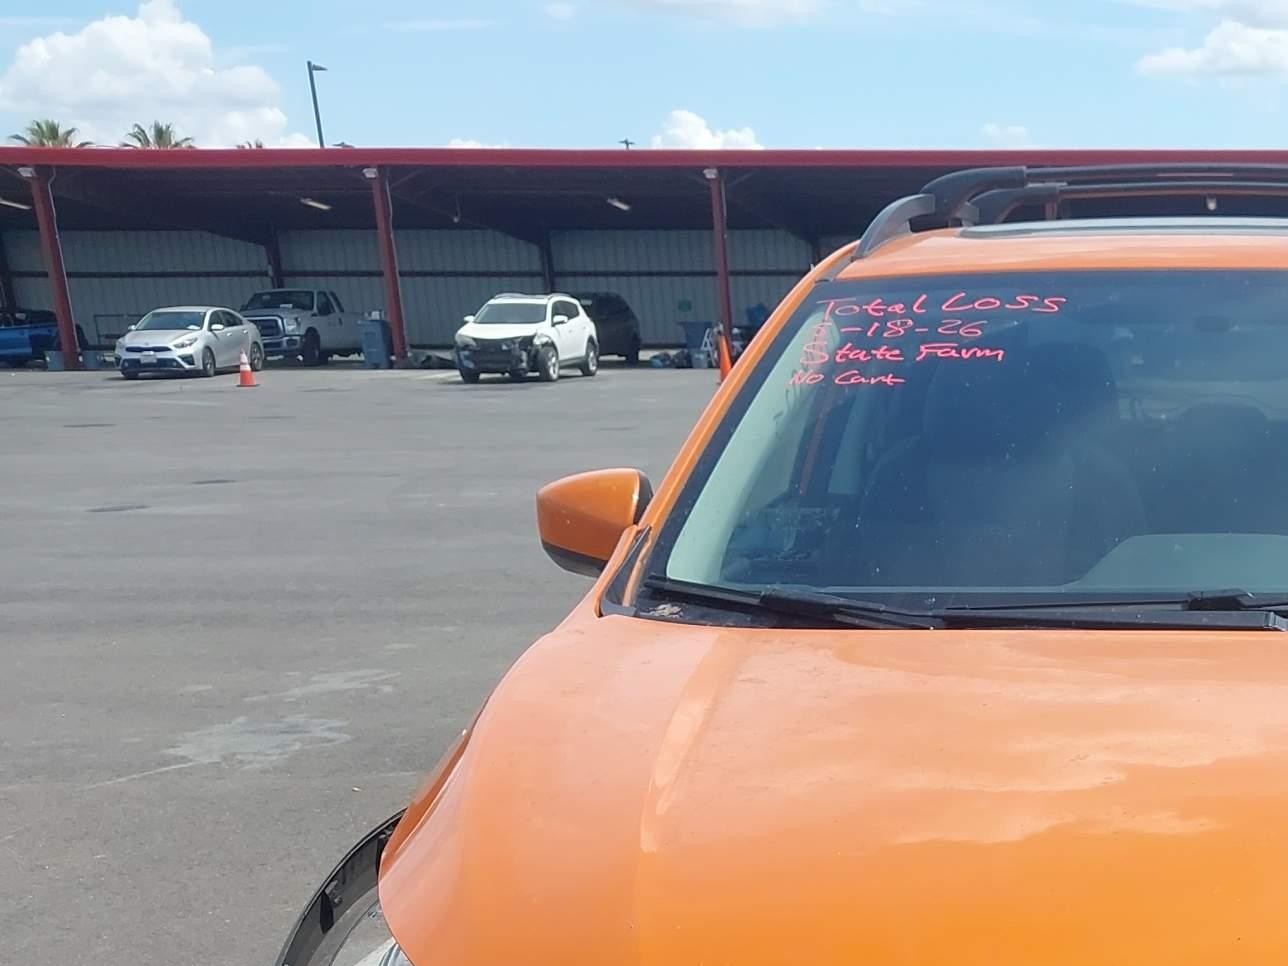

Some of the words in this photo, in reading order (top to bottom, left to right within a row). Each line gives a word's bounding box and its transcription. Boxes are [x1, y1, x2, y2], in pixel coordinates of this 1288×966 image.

[816, 294, 928, 321] Total
[800, 340, 904, 365] State
[916, 343, 1004, 361] Farm
